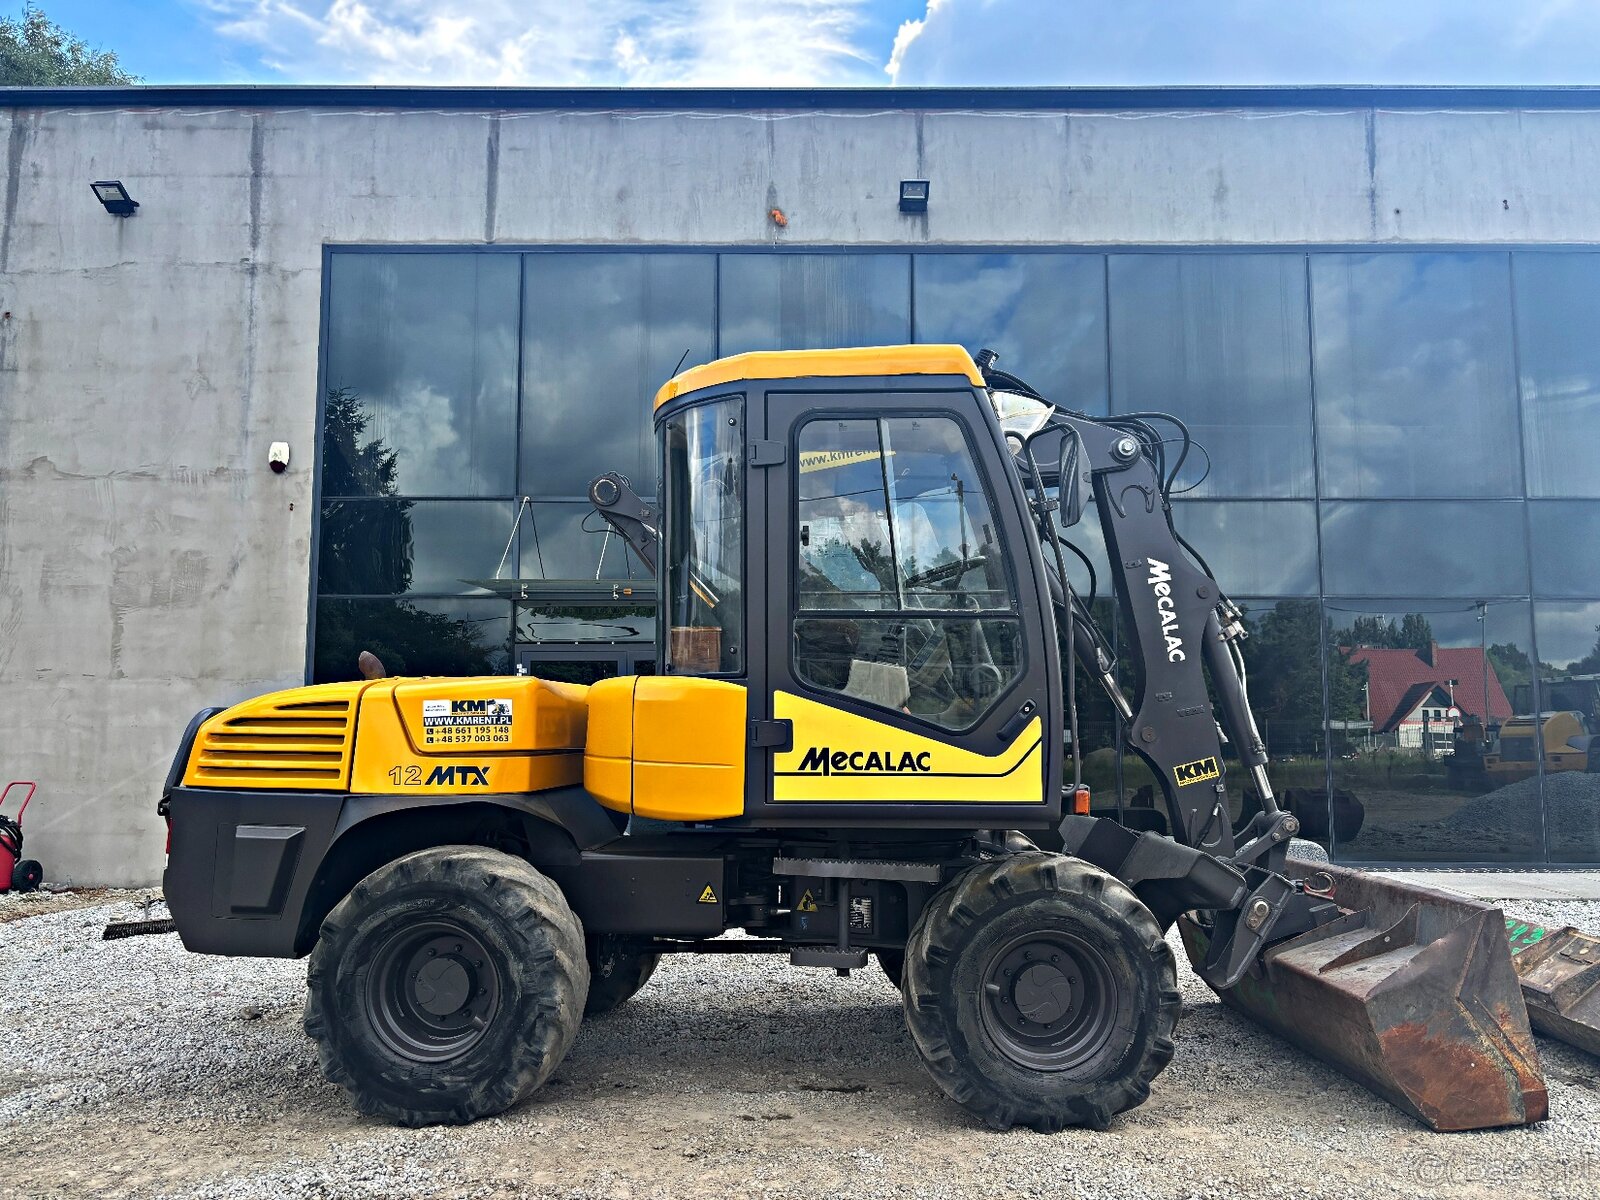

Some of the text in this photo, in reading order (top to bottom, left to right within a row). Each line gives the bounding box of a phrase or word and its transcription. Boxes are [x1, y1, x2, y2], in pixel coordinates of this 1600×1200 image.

[451, 700, 486, 712] KM
[424, 717, 512, 726] WWW.KMRENT.PL
[435, 727, 453, 735] +48
[455, 727, 472, 735] 661
[388, 765, 491, 786] 12 MTX
[1176, 759, 1217, 781] KM
